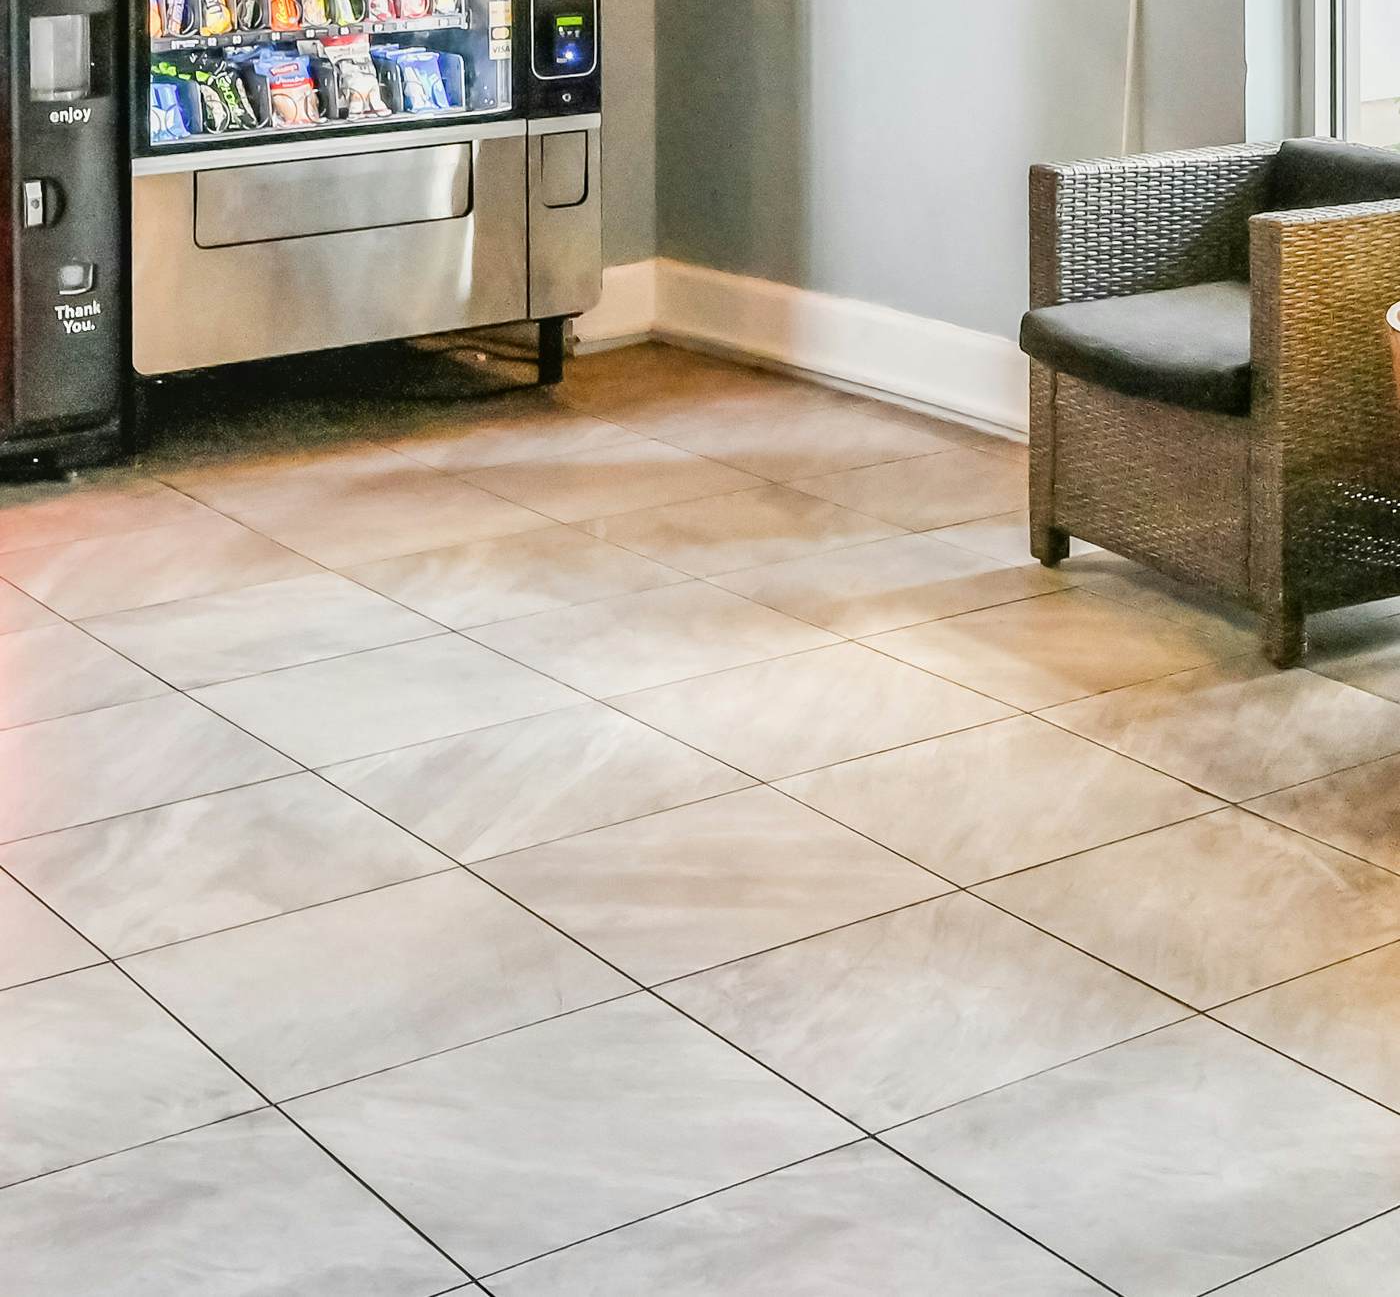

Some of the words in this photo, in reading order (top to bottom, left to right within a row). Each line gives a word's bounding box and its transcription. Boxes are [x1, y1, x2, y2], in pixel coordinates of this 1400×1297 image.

[492, 45, 511, 54] VISA
[49, 106, 92, 123] enjoy
[54, 299, 101, 320] Thank
[63, 319, 96, 334] You.
